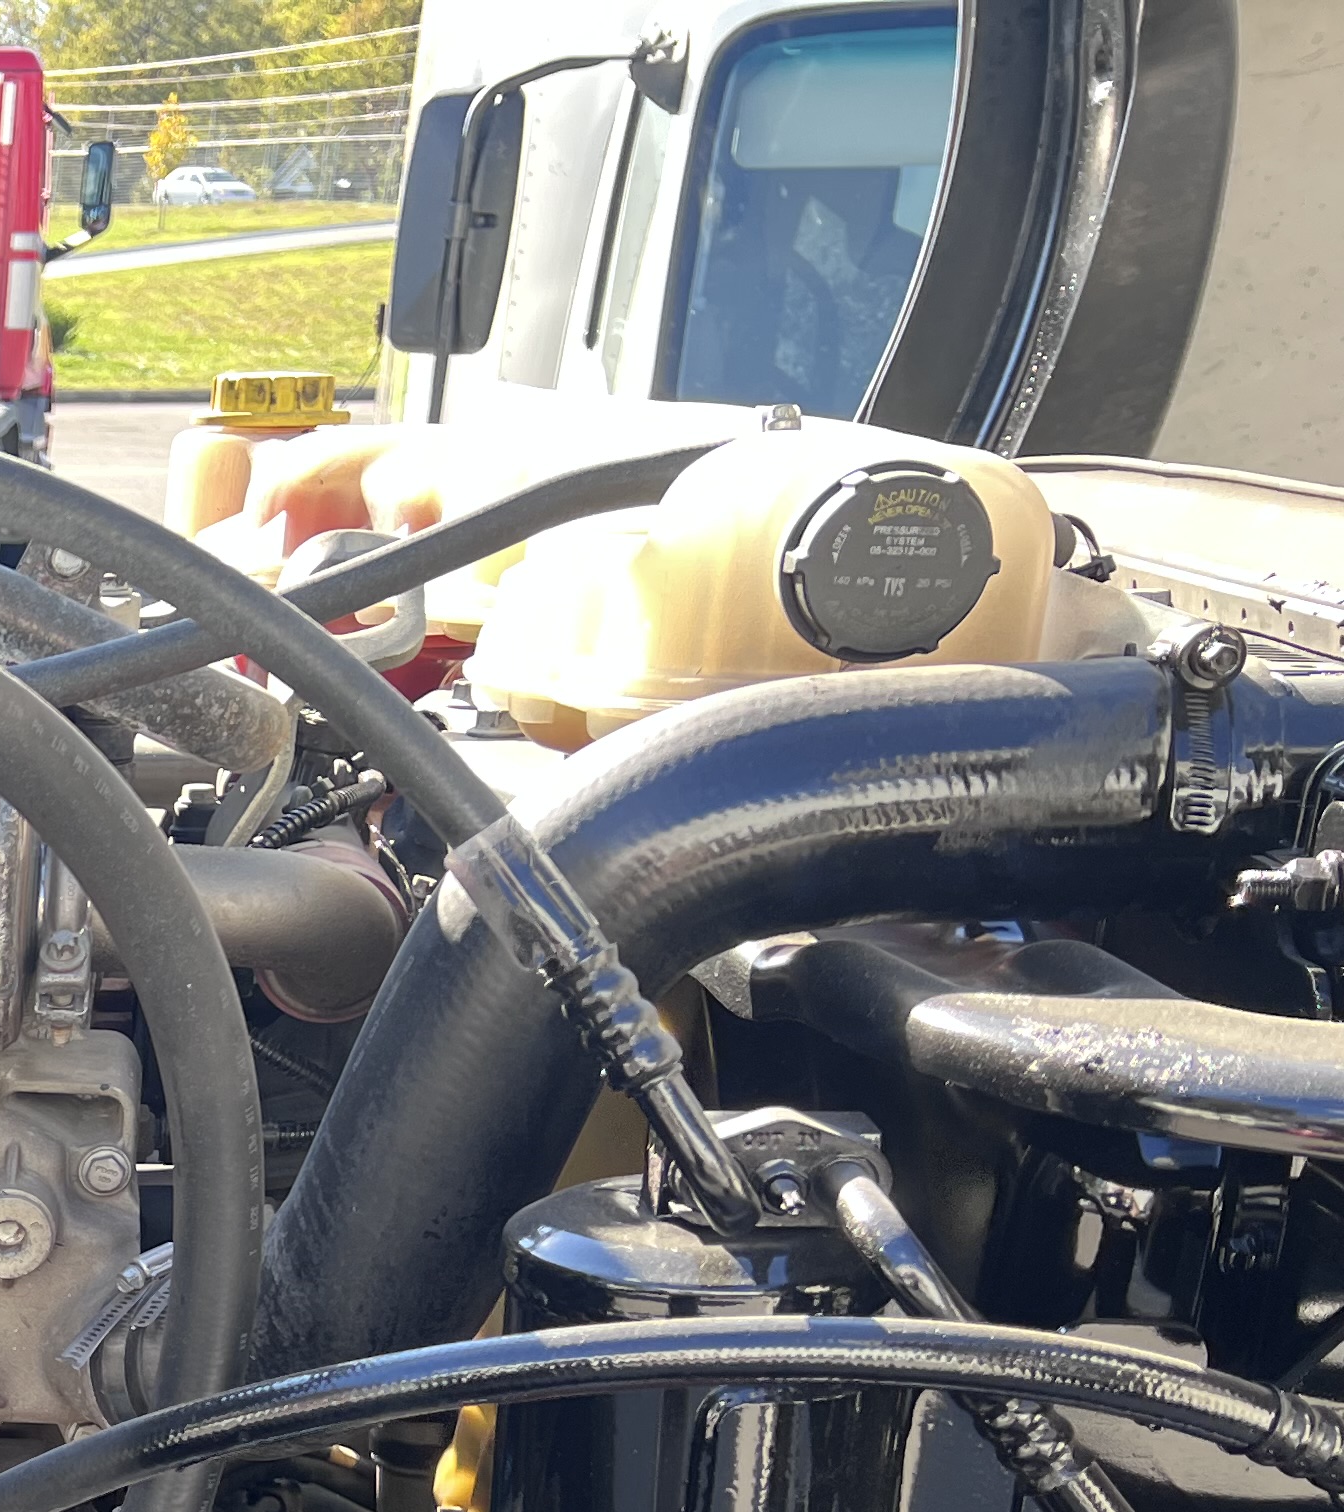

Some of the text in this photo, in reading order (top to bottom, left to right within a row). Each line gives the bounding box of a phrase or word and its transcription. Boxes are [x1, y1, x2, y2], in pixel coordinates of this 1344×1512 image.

[888, 488, 952, 512] CAUTION
[885, 536, 926, 546] SYSTEM
[883, 576, 906, 597] TVS
[742, 1130, 822, 1151] OUT IN
